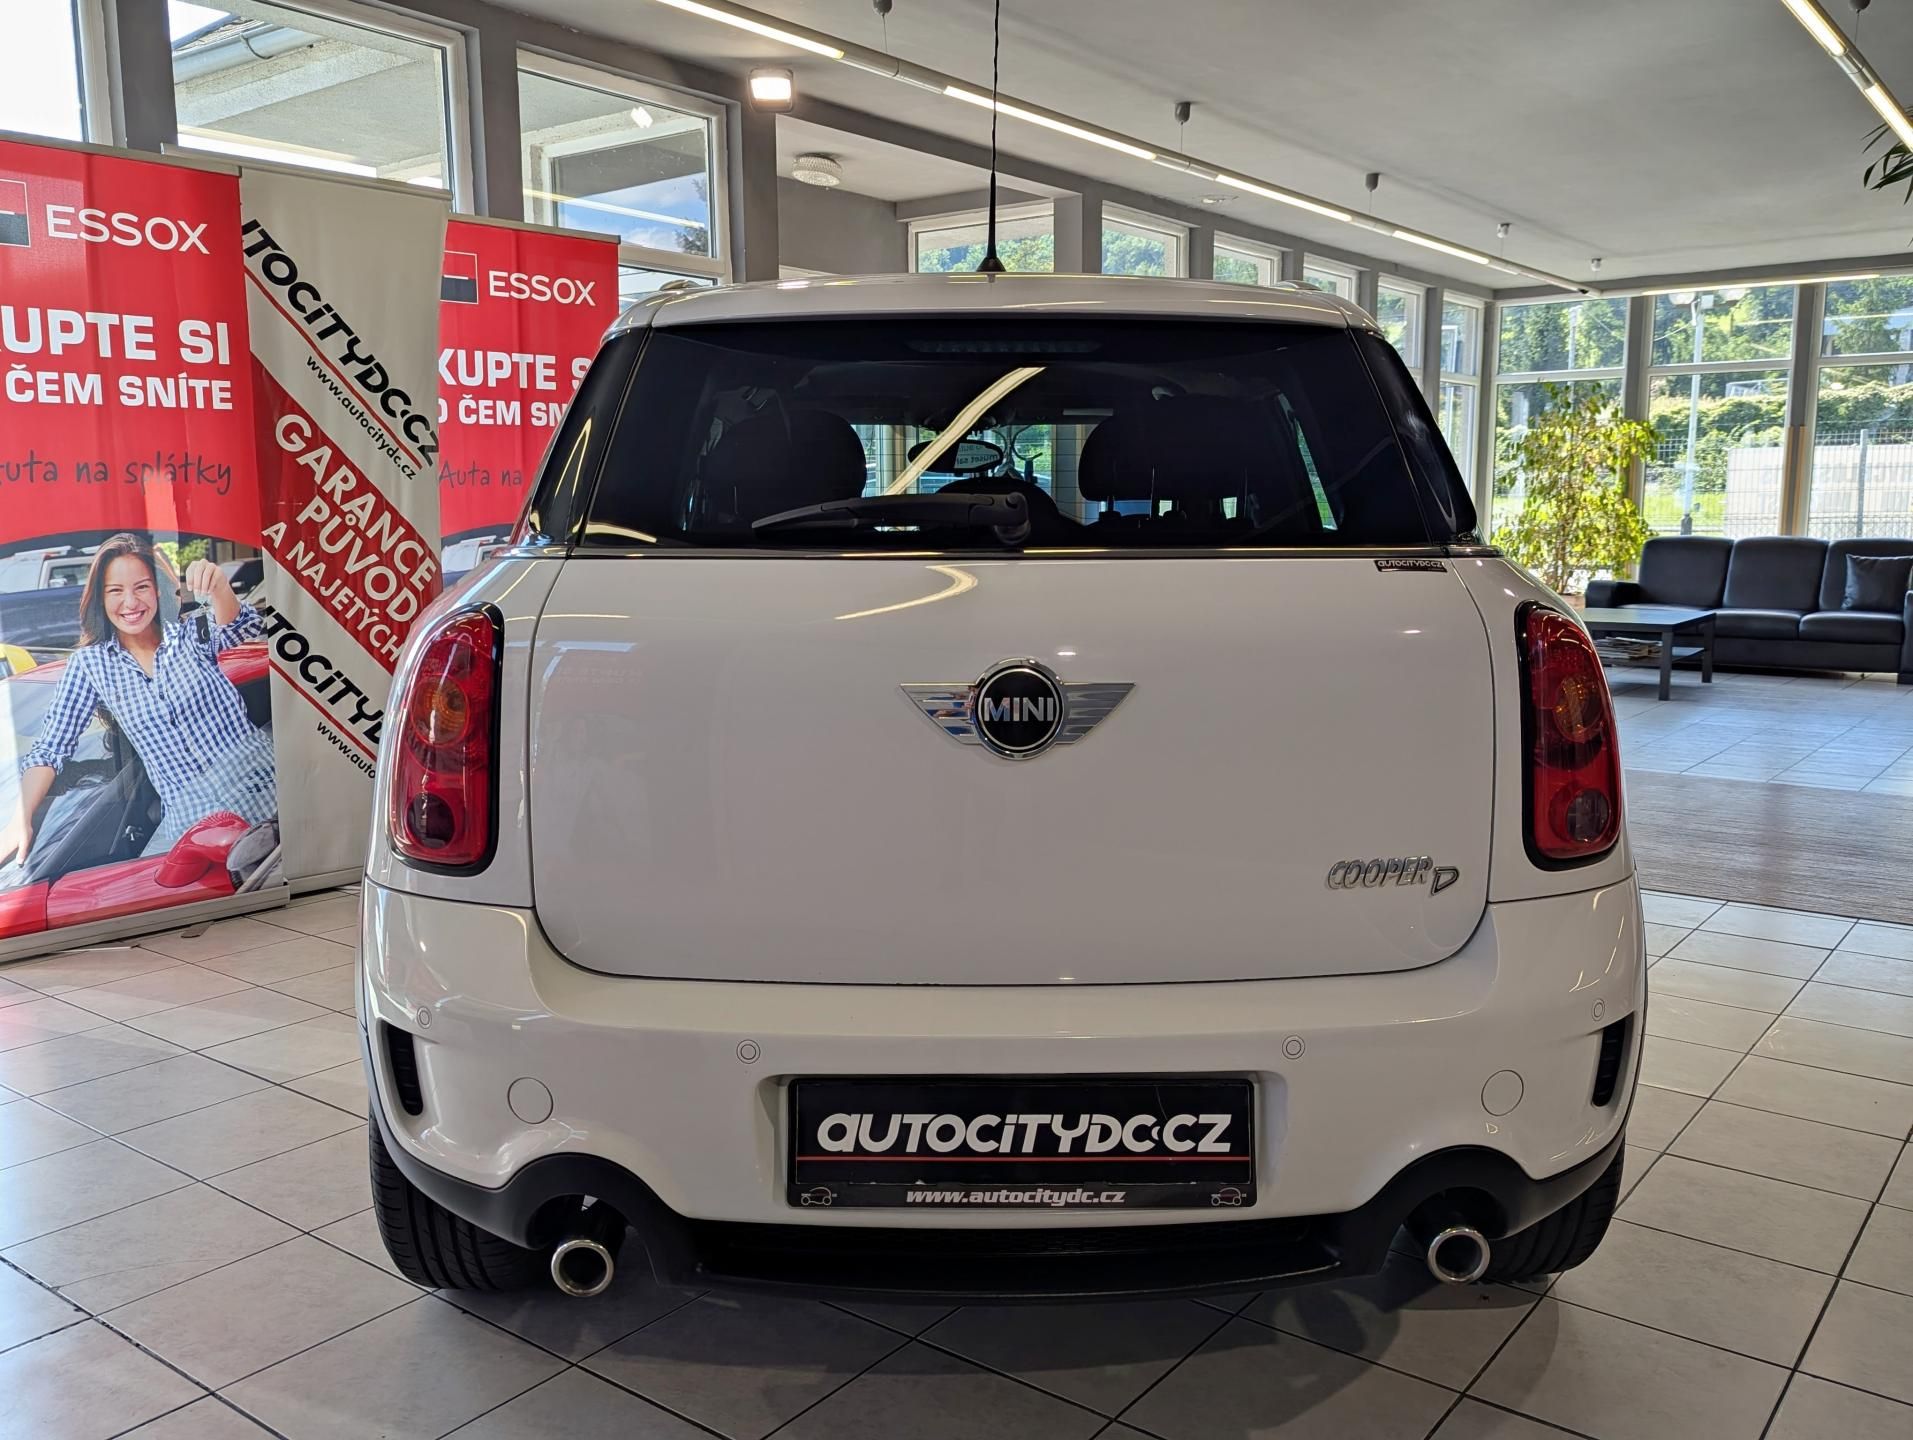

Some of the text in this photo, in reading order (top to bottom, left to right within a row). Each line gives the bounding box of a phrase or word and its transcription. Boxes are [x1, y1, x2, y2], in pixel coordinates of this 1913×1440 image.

[45, 203, 210, 255] ESSOX
[488, 270, 596, 307] ESSOX
[0, 305, 231, 366] UPTE SI
[5, 363, 233, 410] ČEM SNÍTE
[306, 355, 417, 481] www.autocitydc.cz
[458, 394, 521, 425] ČEM
[76, 461, 109, 484] na
[124, 450, 232, 496] splátky
[439, 460, 523, 489] Auta na
[275, 414, 437, 593] GARANCE
[261, 521, 287, 549] A
[295, 494, 418, 622] PŮVOD
[983, 696, 1054, 722] MINI
[1327, 855, 1460, 896] COOPER D
[906, 1188, 1126, 1207] www.autocitydc.cz
